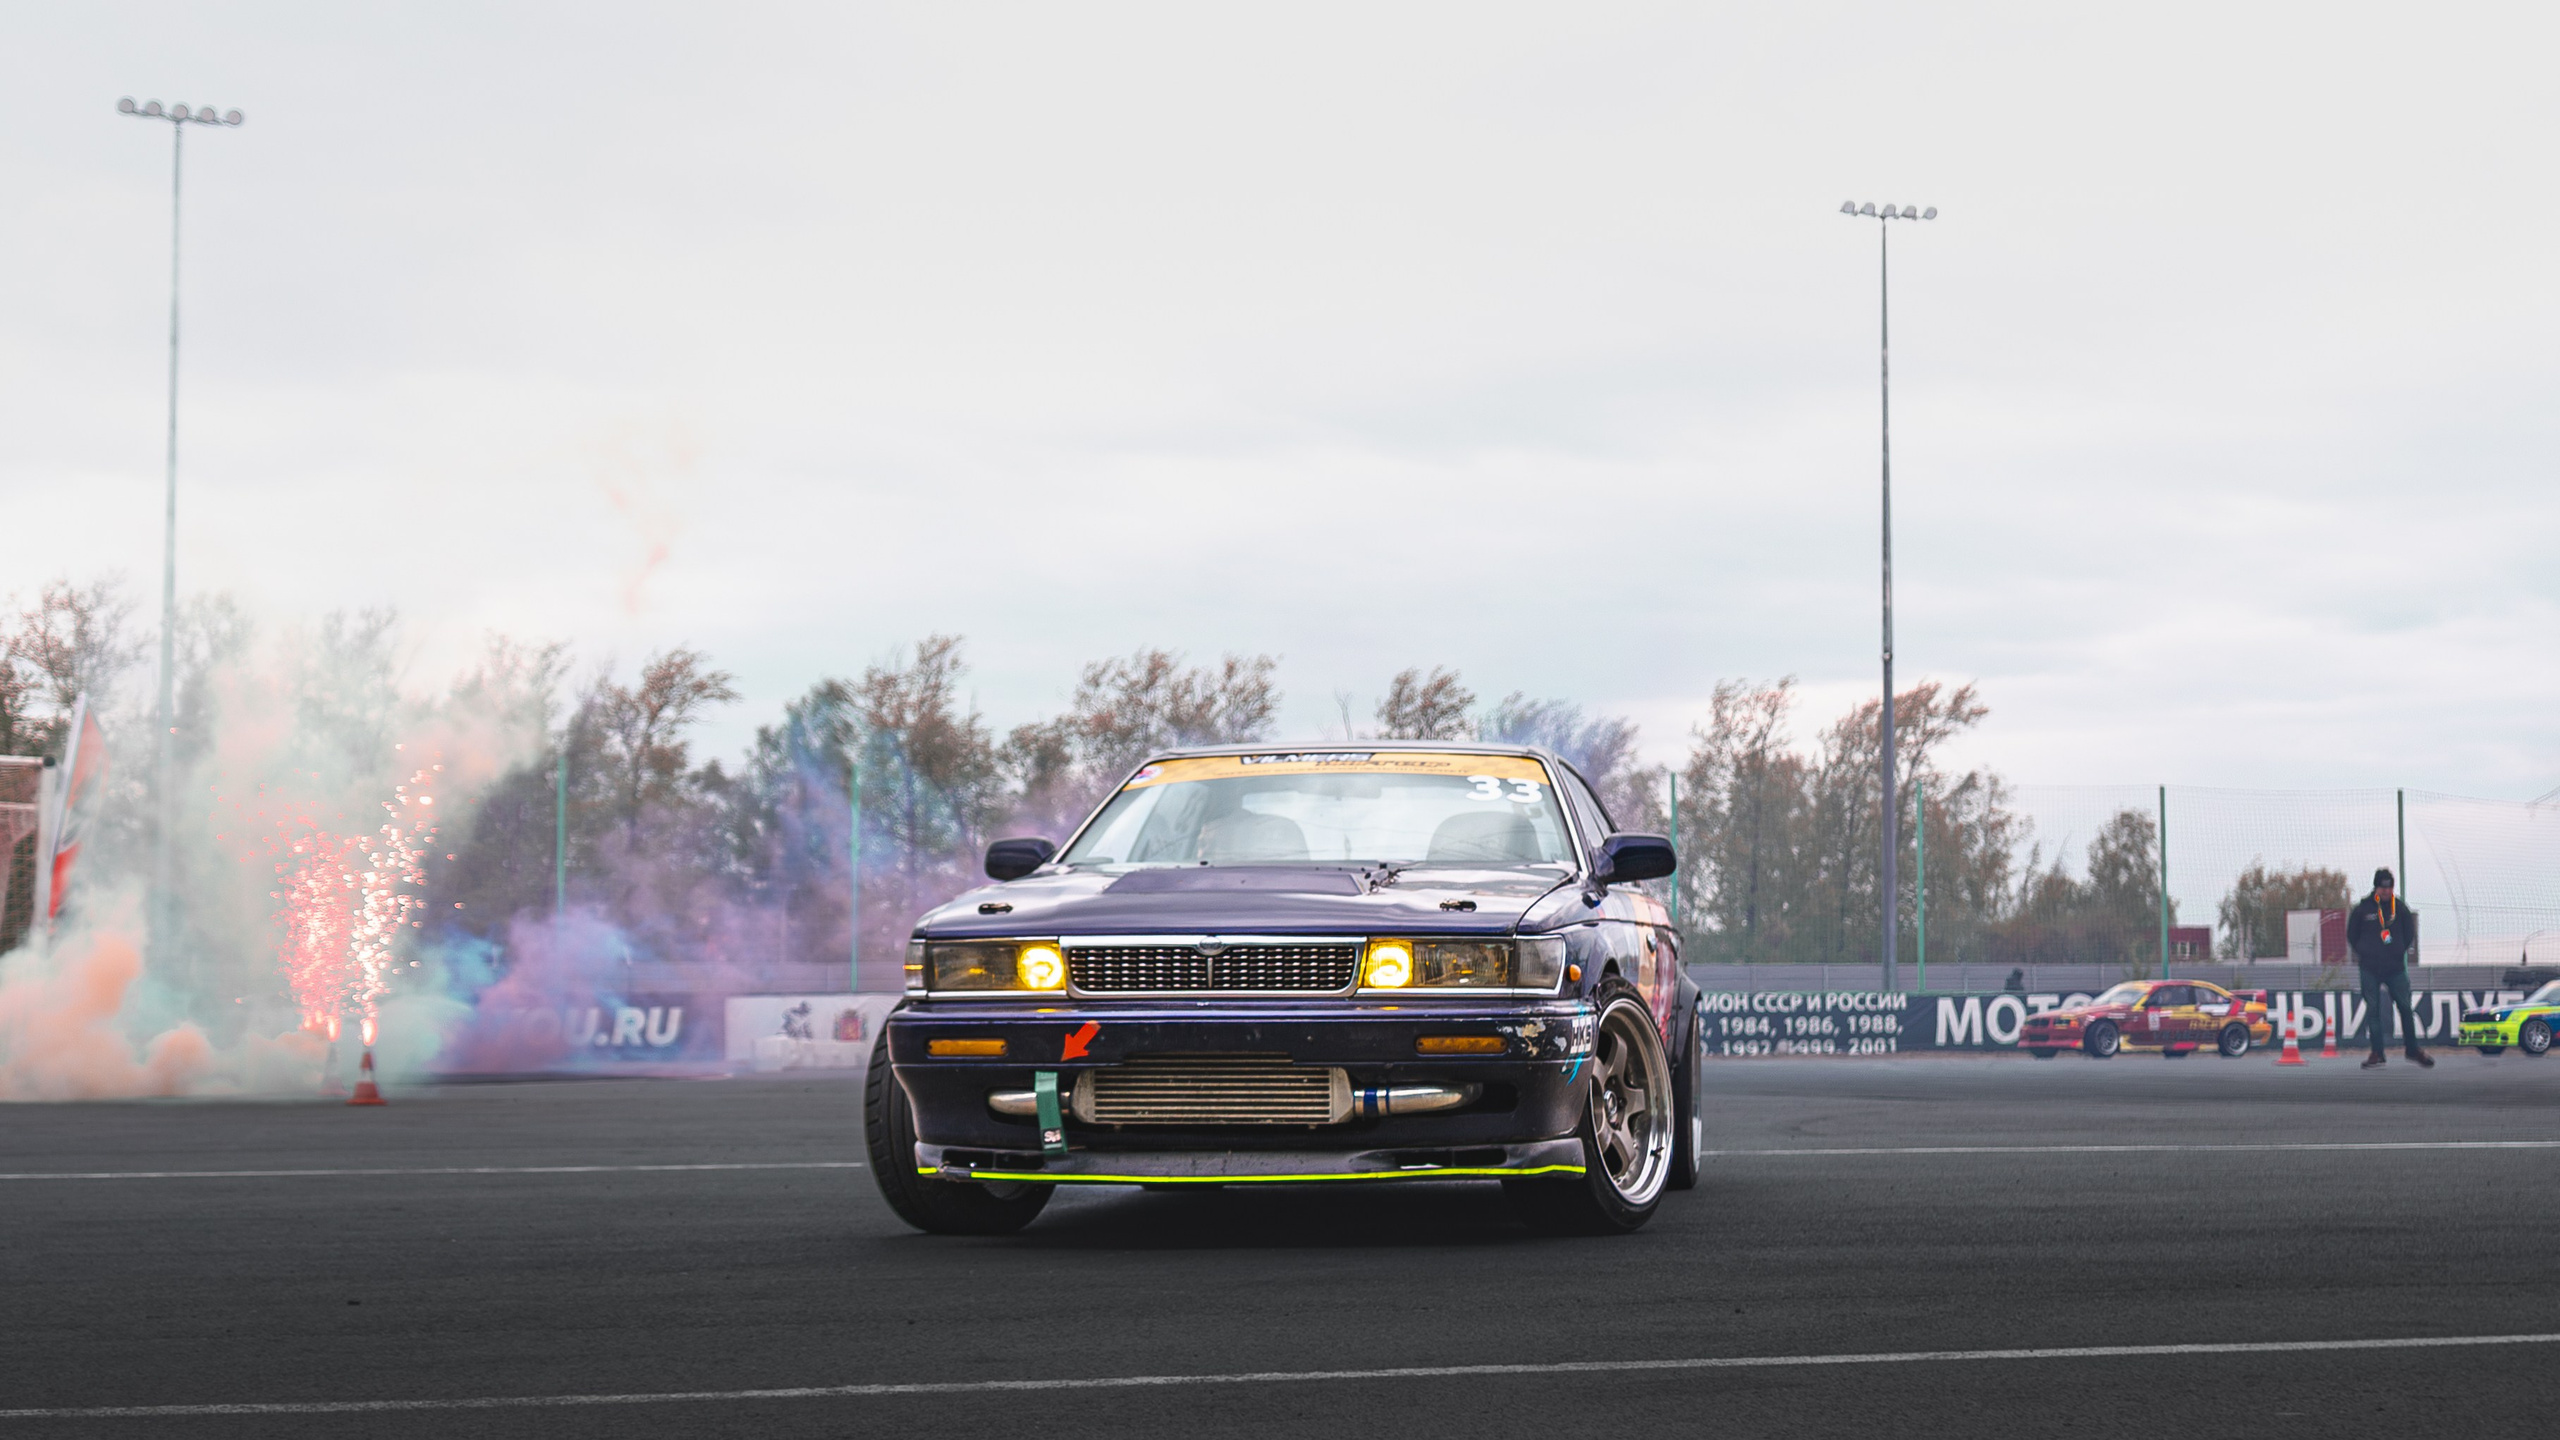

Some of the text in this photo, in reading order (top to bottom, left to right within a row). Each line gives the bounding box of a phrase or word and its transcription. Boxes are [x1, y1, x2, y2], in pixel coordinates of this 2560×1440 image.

[1466, 775, 1543, 803] 33
[1752, 993, 1803, 1013] СССР
[1806, 993, 1821, 1013] И
[1825, 992, 1907, 1012] РОССИИ
[1719, 1016, 1777, 1037] 1984,
[1784, 1015, 1840, 1037] 1986,
[1847, 1014, 1904, 1035] 1988,
[1848, 1037, 1897, 1056] 2001
